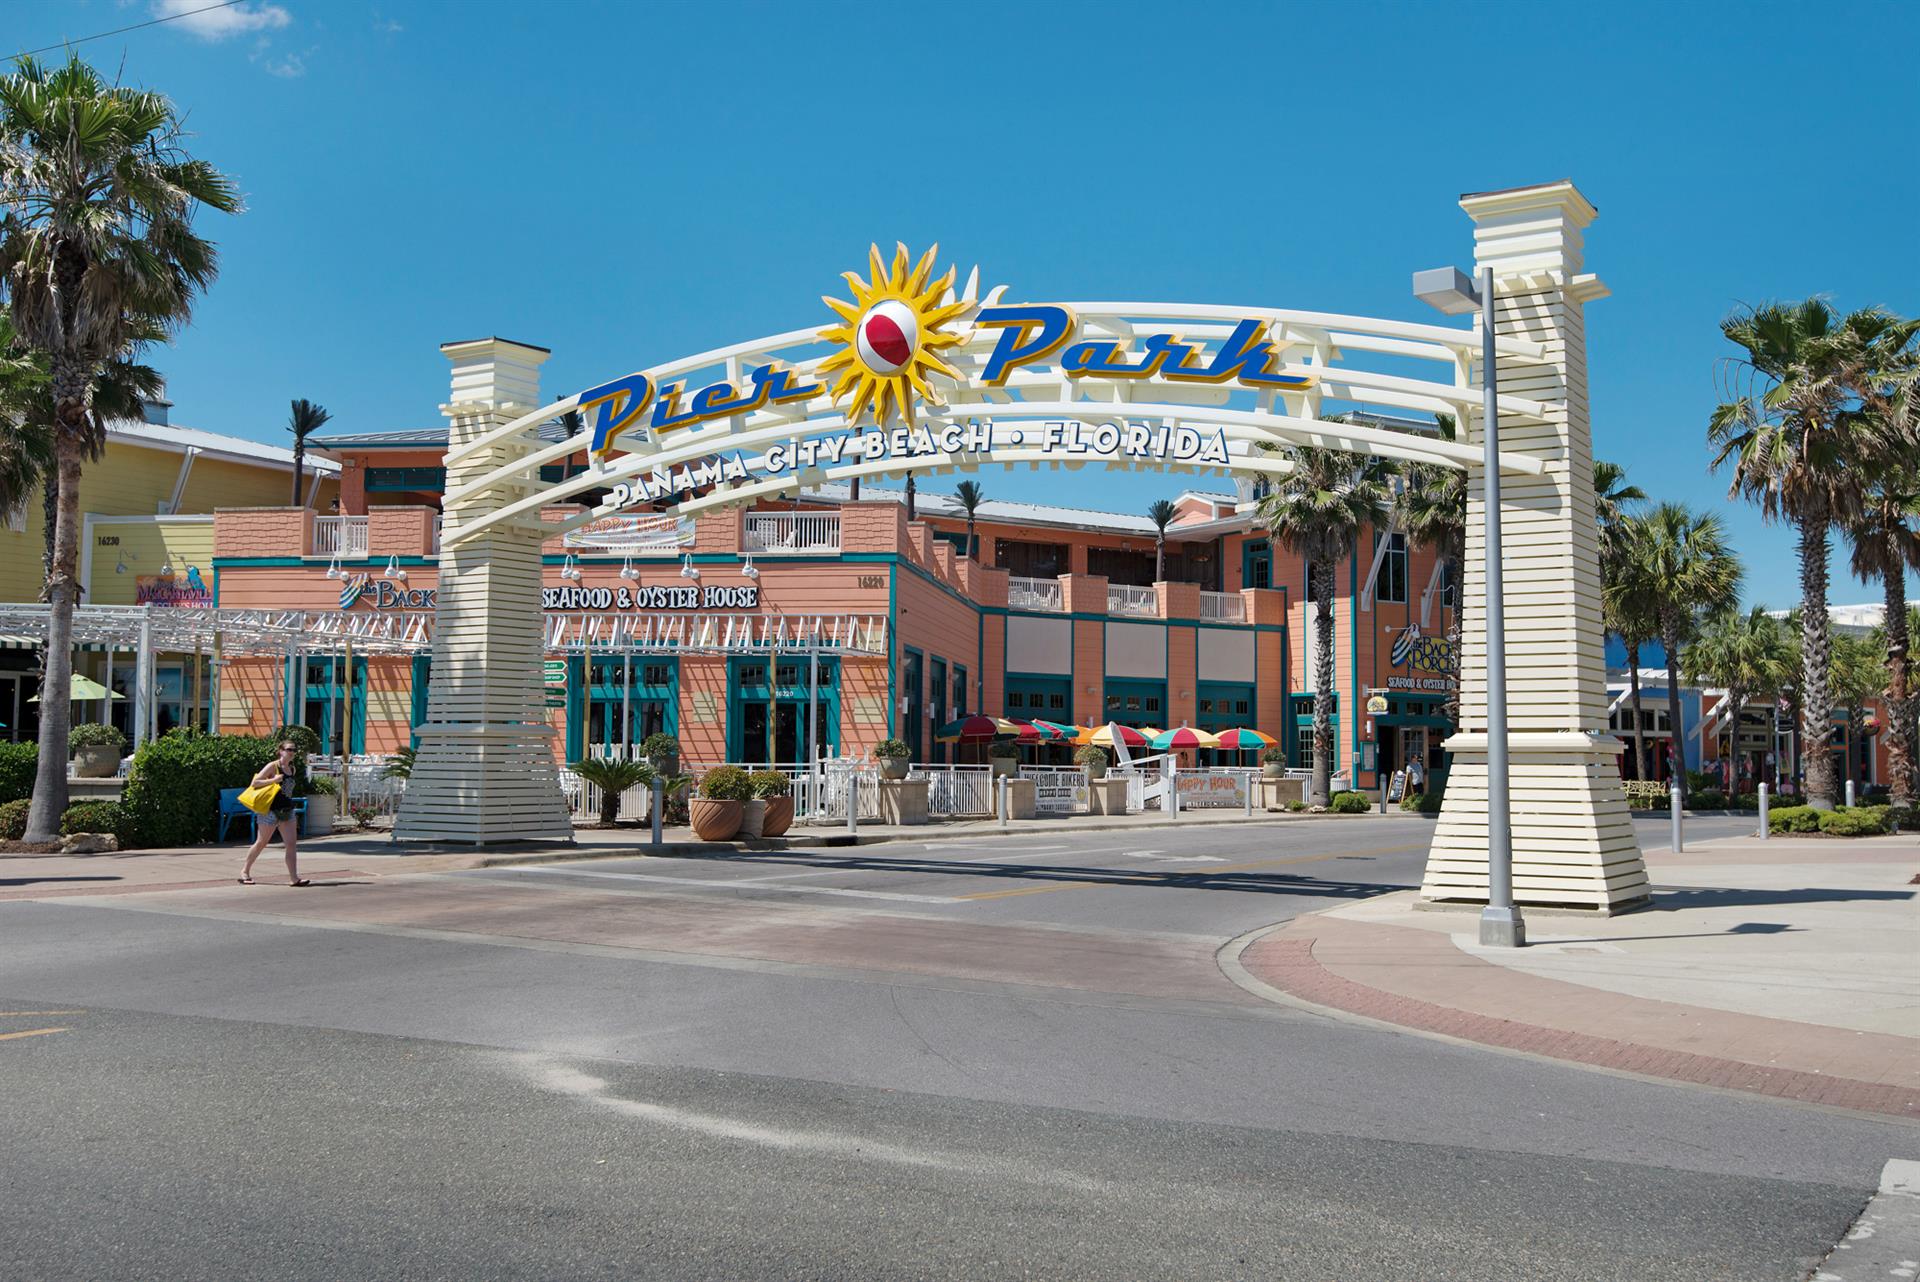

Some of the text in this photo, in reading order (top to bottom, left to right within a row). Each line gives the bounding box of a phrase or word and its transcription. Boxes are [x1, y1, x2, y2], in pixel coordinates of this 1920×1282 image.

[577, 304, 1318, 457] Pier Park
[612, 421, 1231, 509] PANAMA CITY BEACH FLORIDA
[376, 580, 436, 608] BACK
[542, 586, 759, 609] SEAFOOD & OYSTER HOUSE
[1388, 676, 1416, 688] SEAFOOD
[1416, 678, 1422, 688] &
[1422, 678, 1446, 690] OYSTER
[1062, 773, 1084, 787] BIKERS
[1209, 776, 1236, 790] HOUR
